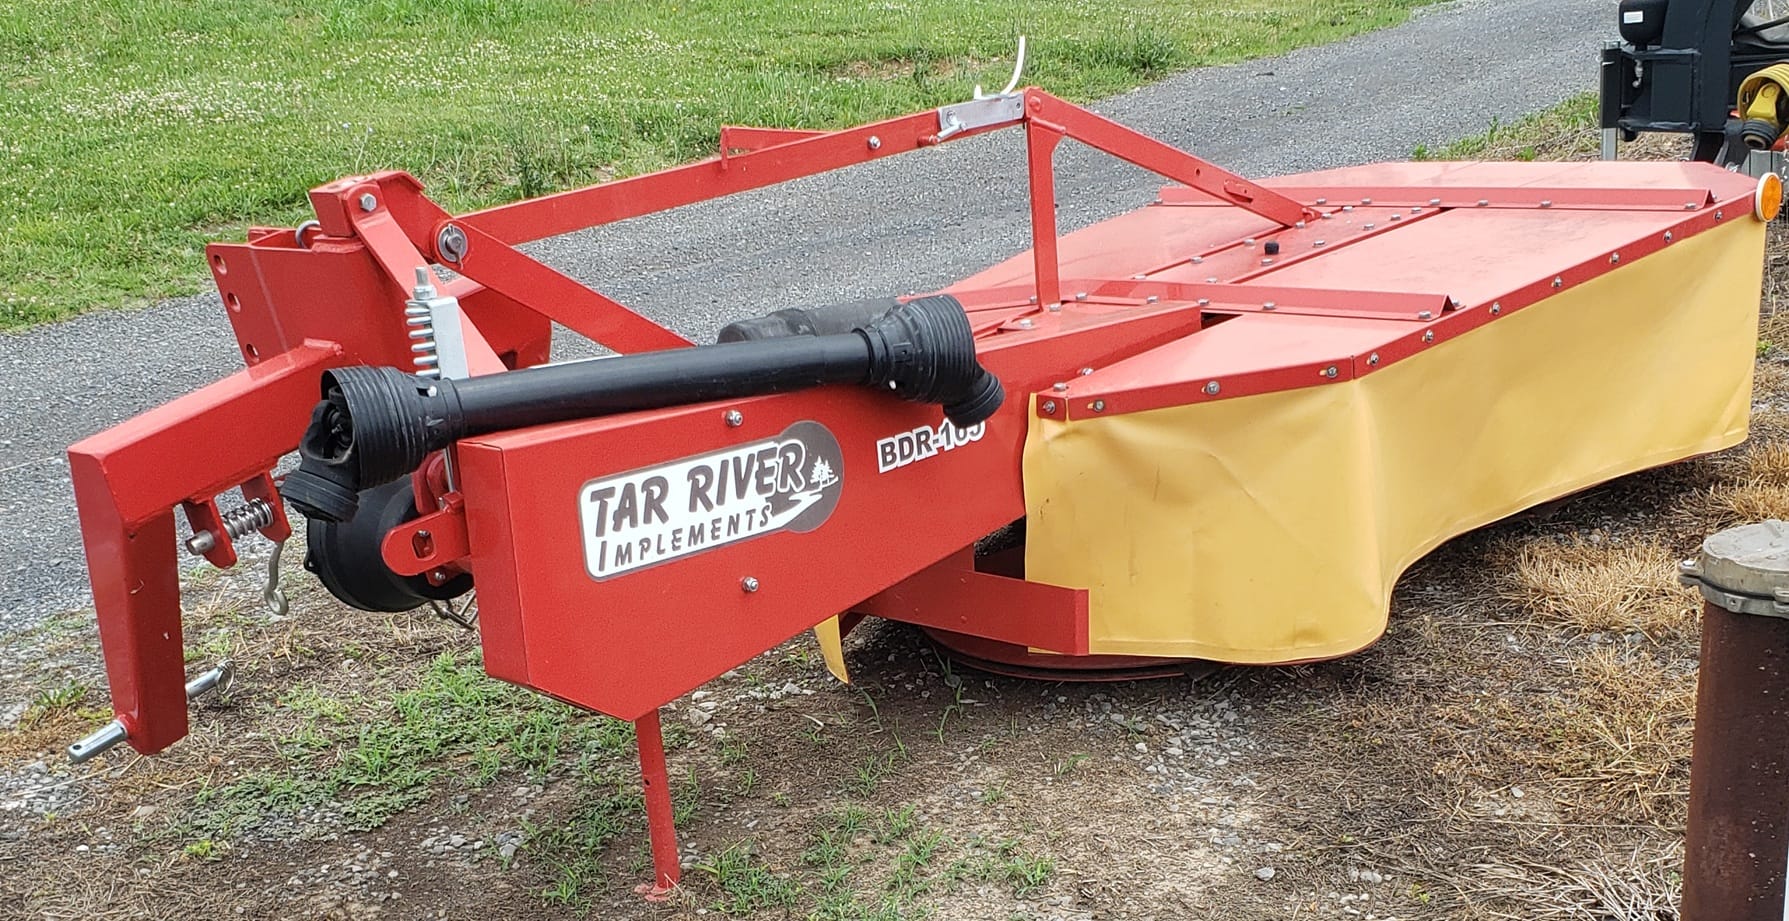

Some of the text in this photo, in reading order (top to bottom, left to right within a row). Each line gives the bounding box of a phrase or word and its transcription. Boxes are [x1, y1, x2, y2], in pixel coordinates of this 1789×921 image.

[590, 443, 805, 538] TAR RIVER
[598, 504, 771, 572] IMPLEMENTS
